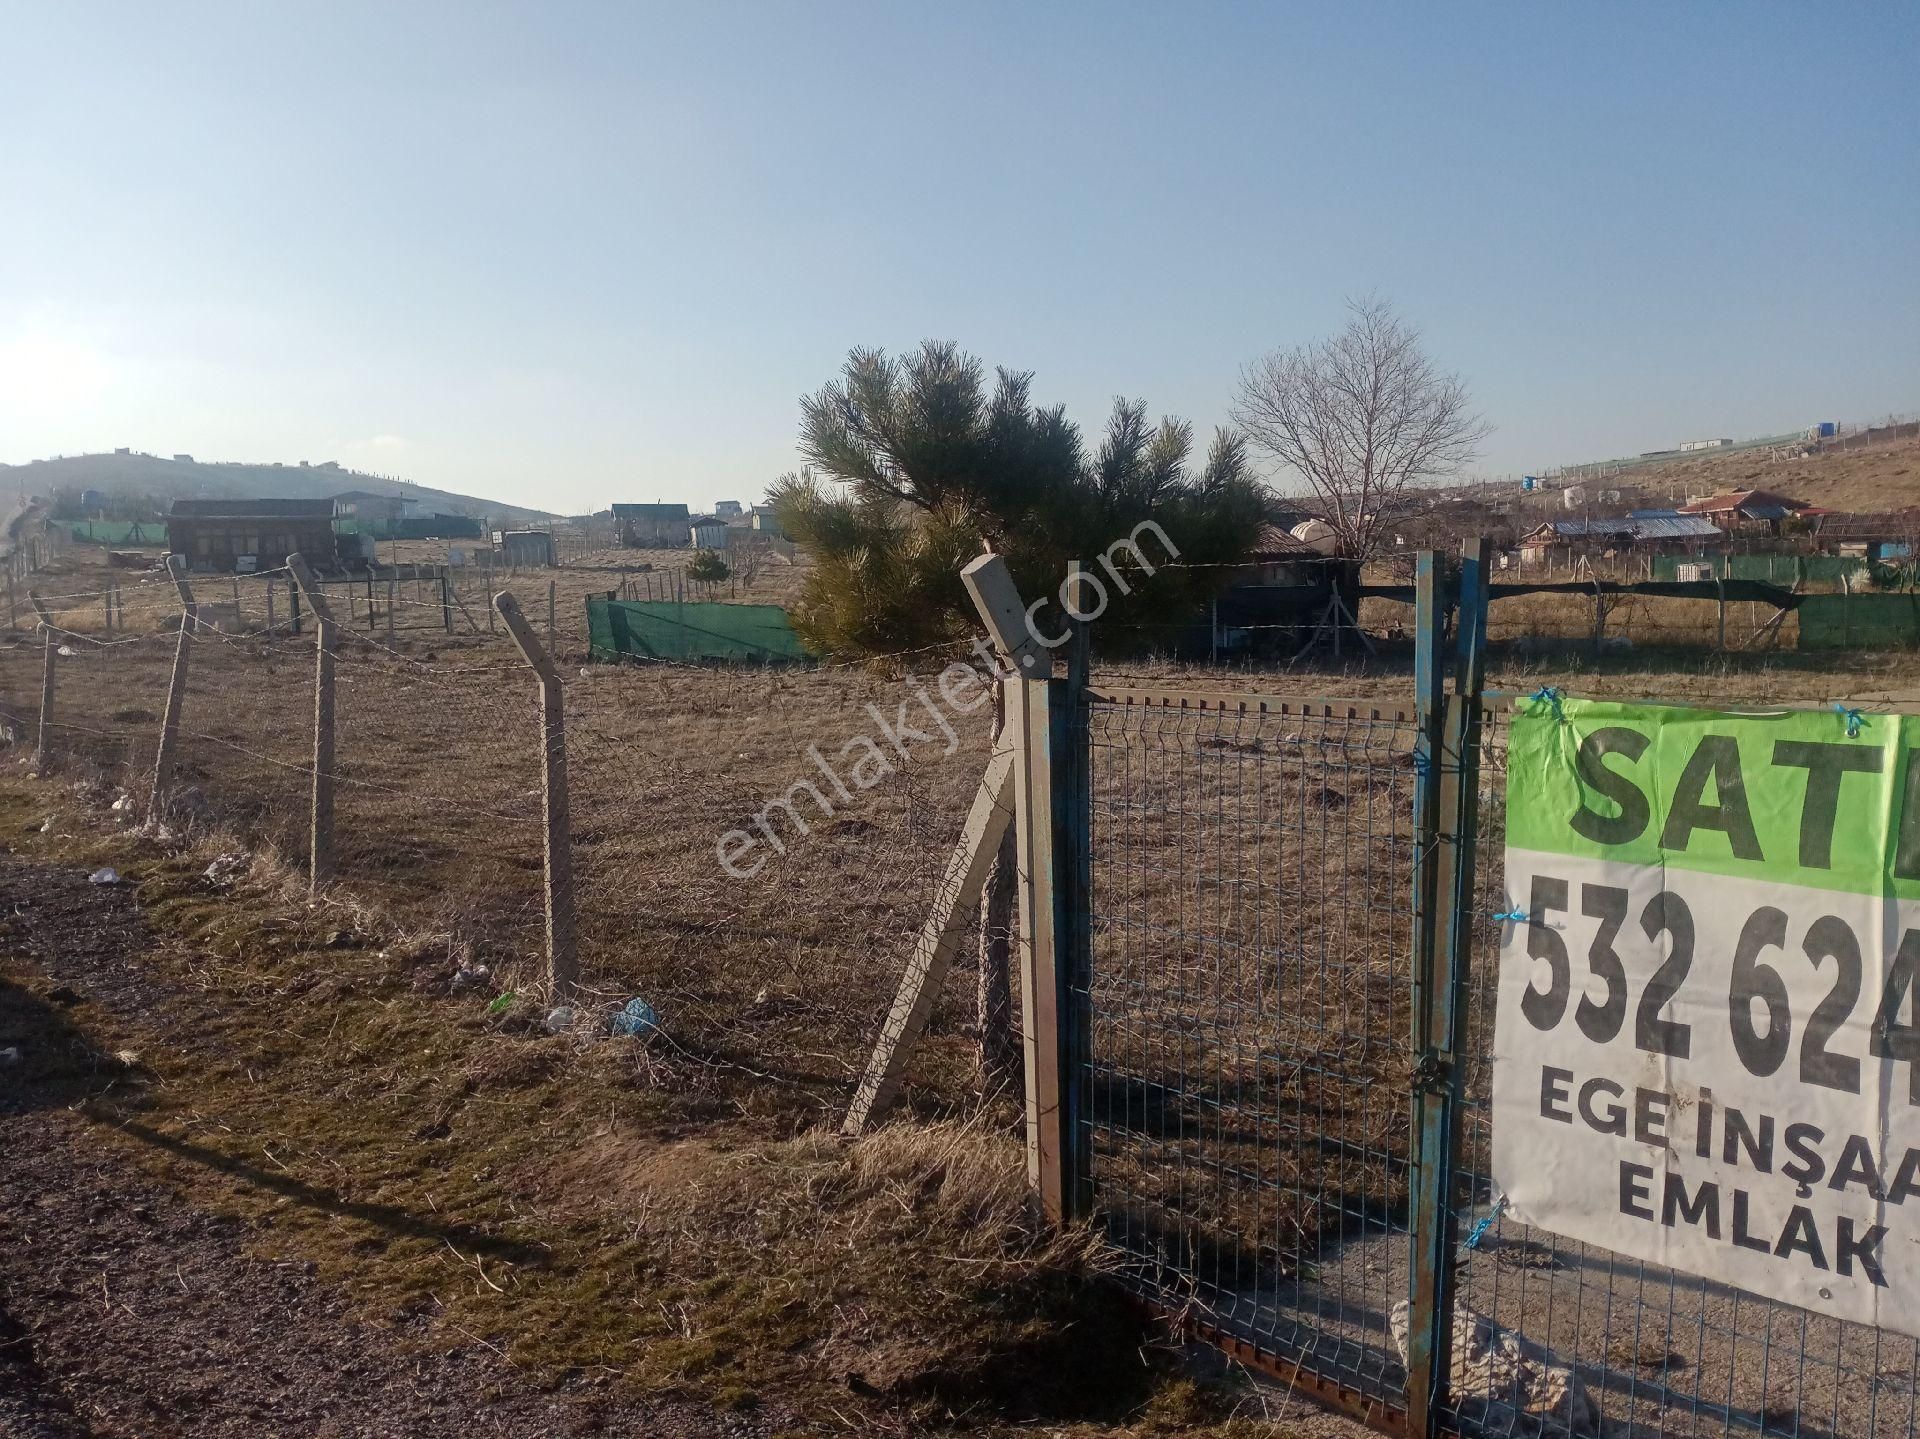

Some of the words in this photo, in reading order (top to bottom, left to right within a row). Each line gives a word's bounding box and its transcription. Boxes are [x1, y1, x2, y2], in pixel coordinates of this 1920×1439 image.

[1520, 875, 1695, 1060] 532
[1729, 905, 1920, 1106] 624
[1540, 1065, 1671, 1149] EGE
[1619, 1160, 1890, 1288] EMLAK
